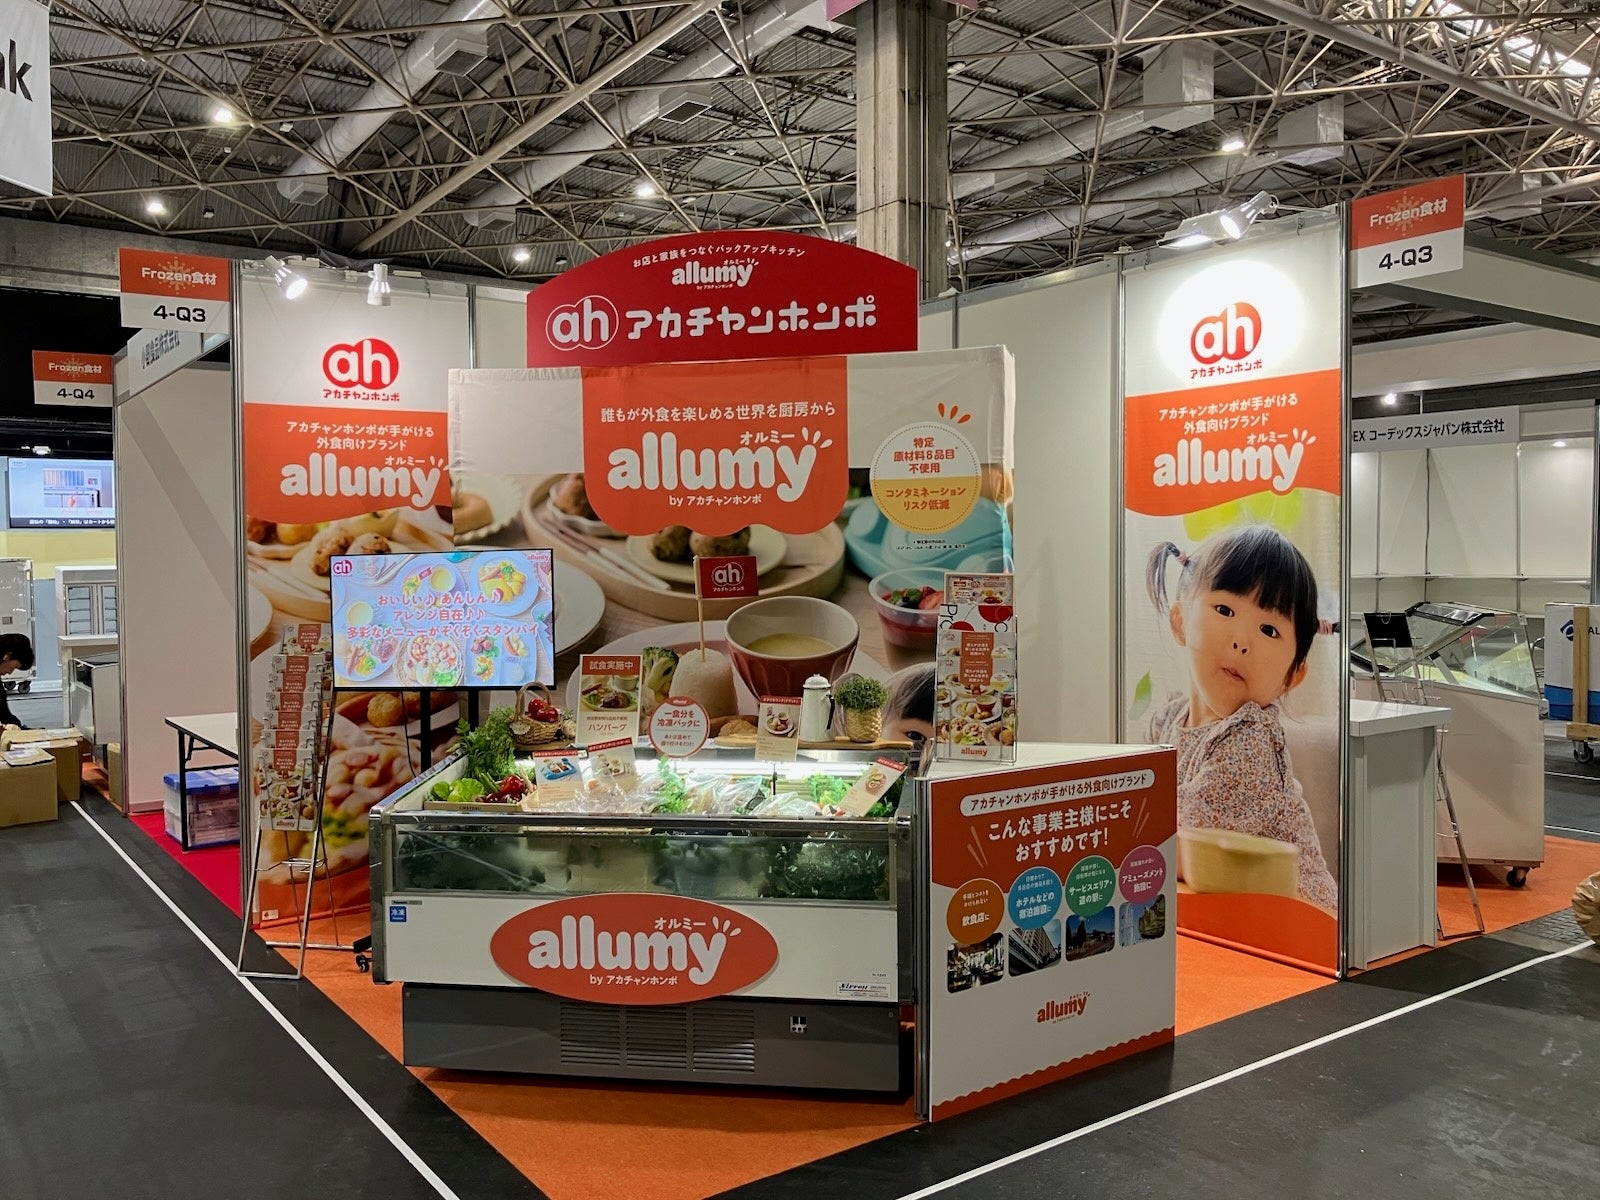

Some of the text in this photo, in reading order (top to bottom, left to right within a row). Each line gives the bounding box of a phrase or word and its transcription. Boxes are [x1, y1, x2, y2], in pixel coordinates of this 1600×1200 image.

[1369, 198, 1448, 228] Frozen食材
[632, 244, 806, 268] お店と家族をつなぐバックアップキッチン
[1378, 245, 1434, 270] 4-Q3
[141, 267, 217, 286] Frozen食材
[671, 261, 754, 288] allumy
[153, 304, 206, 322] 4-Q3
[552, 294, 877, 344] ah アカチャンホンポ
[1194, 304, 1255, 359] ah
[328, 339, 392, 385] ah
[57, 388, 95, 400] 4-Q4
[601, 401, 836, 424] 誰もが外食を楽しめる世界を厨房から
[1159, 392, 1299, 422] アカチャンホンポが手がける
[287, 421, 435, 438] アカチャンホンポが手がける
[1184, 413, 1270, 436] 外食向けブランド
[1369, 418, 1505, 441] コーデックスジャパン株式会社
[316, 436, 408, 452] 外食向けブランド
[740, 430, 796, 446] オルミー
[913, 437, 935, 448] 特定
[1247, 432, 1289, 445] オルミー
[385, 456, 426, 466] オルミー
[607, 431, 818, 503] allumy
[909, 463, 941, 474] 不使用
[1153, 437, 1305, 492] allumy
[280, 452, 442, 508] allumy
[669, 493, 763, 508] by アカチャンホンポ
[886, 487, 967, 499] コンタミネーション
[903, 499, 951, 511] リスク低減
[714, 562, 741, 583] ah
[588, 723, 627, 731] ハンバーグ
[971, 773, 1148, 812] アカチャンホンポが手がける外食向けブランド
[988, 799, 1132, 842] こんな事業主様にこそ
[1015, 827, 1110, 862] おすすめです!
[1016, 891, 1055, 908] ホテルなどの
[654, 916, 707, 931] オルミー
[528, 914, 728, 986] allumy
[590, 974, 603, 986] by
[1037, 996, 1087, 1023] allumy
